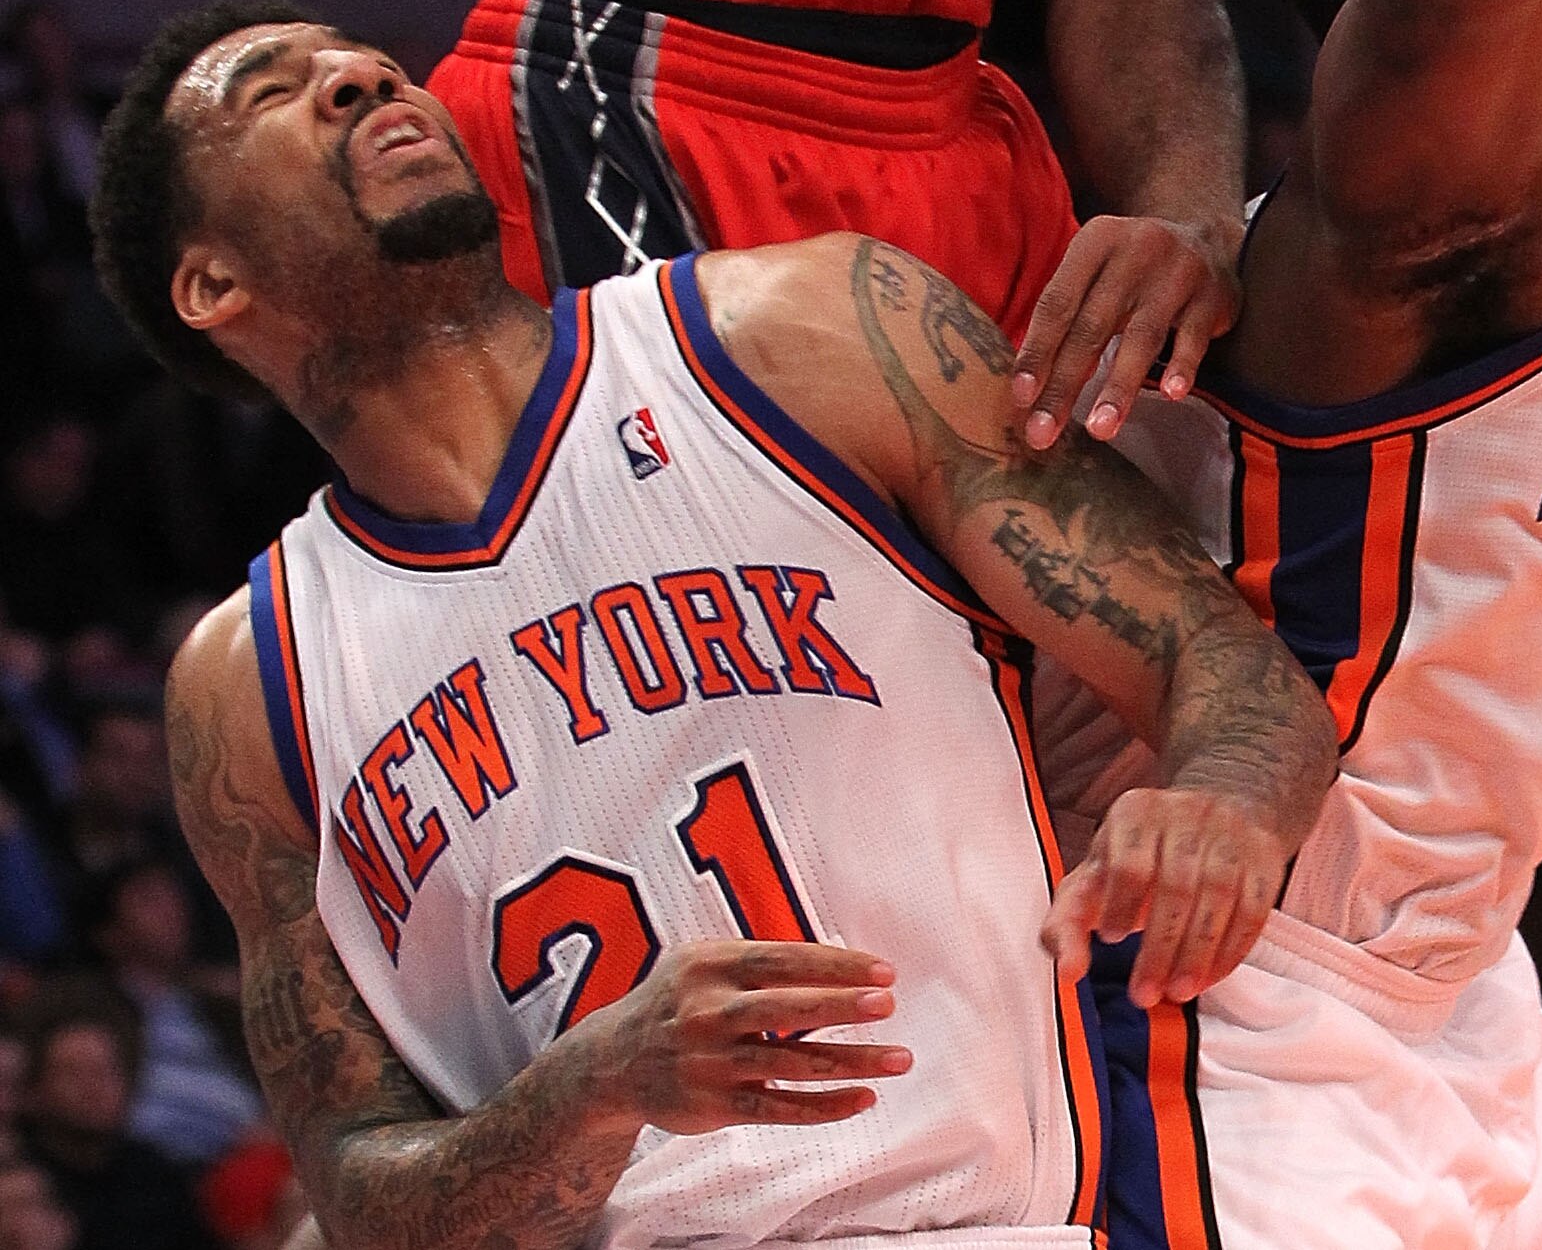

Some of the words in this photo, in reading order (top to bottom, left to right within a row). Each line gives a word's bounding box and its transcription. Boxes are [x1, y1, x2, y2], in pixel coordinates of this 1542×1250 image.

[337, 657, 519, 967] NEW
[510, 564, 882, 746] YORK
[489, 752, 846, 1042] 21
